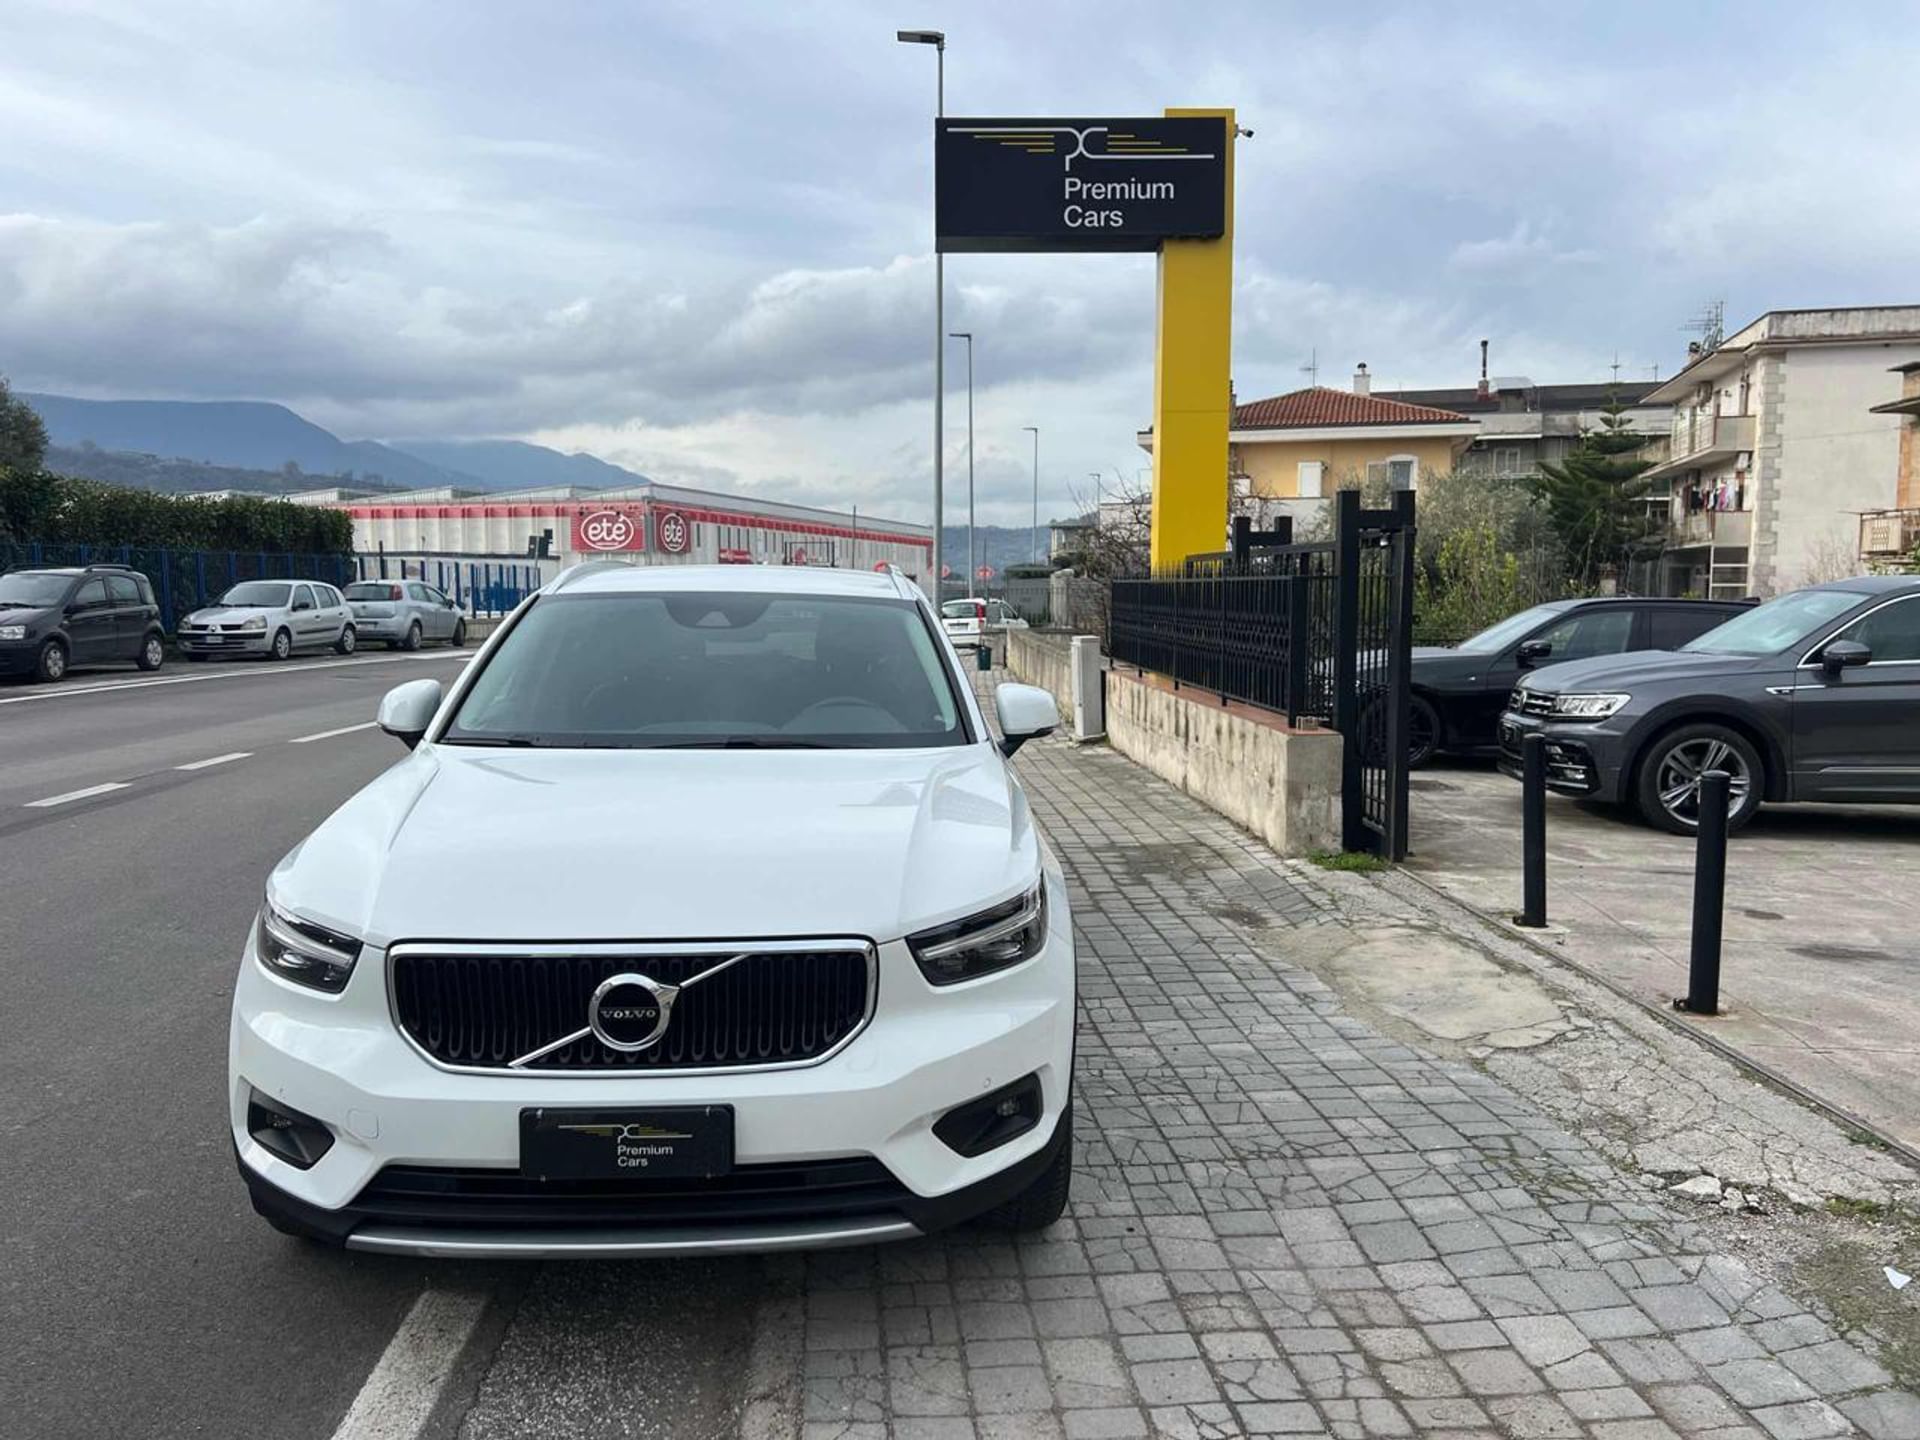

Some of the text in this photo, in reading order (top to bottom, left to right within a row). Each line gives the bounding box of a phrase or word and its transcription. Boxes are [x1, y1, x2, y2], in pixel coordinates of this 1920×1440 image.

[1064, 177, 1174, 200] Premium
[1063, 205, 1124, 227] Cars
[600, 1009, 656, 1018] VOLVO
[617, 1145, 673, 1155] Premium
[617, 1156, 648, 1167] Cars
